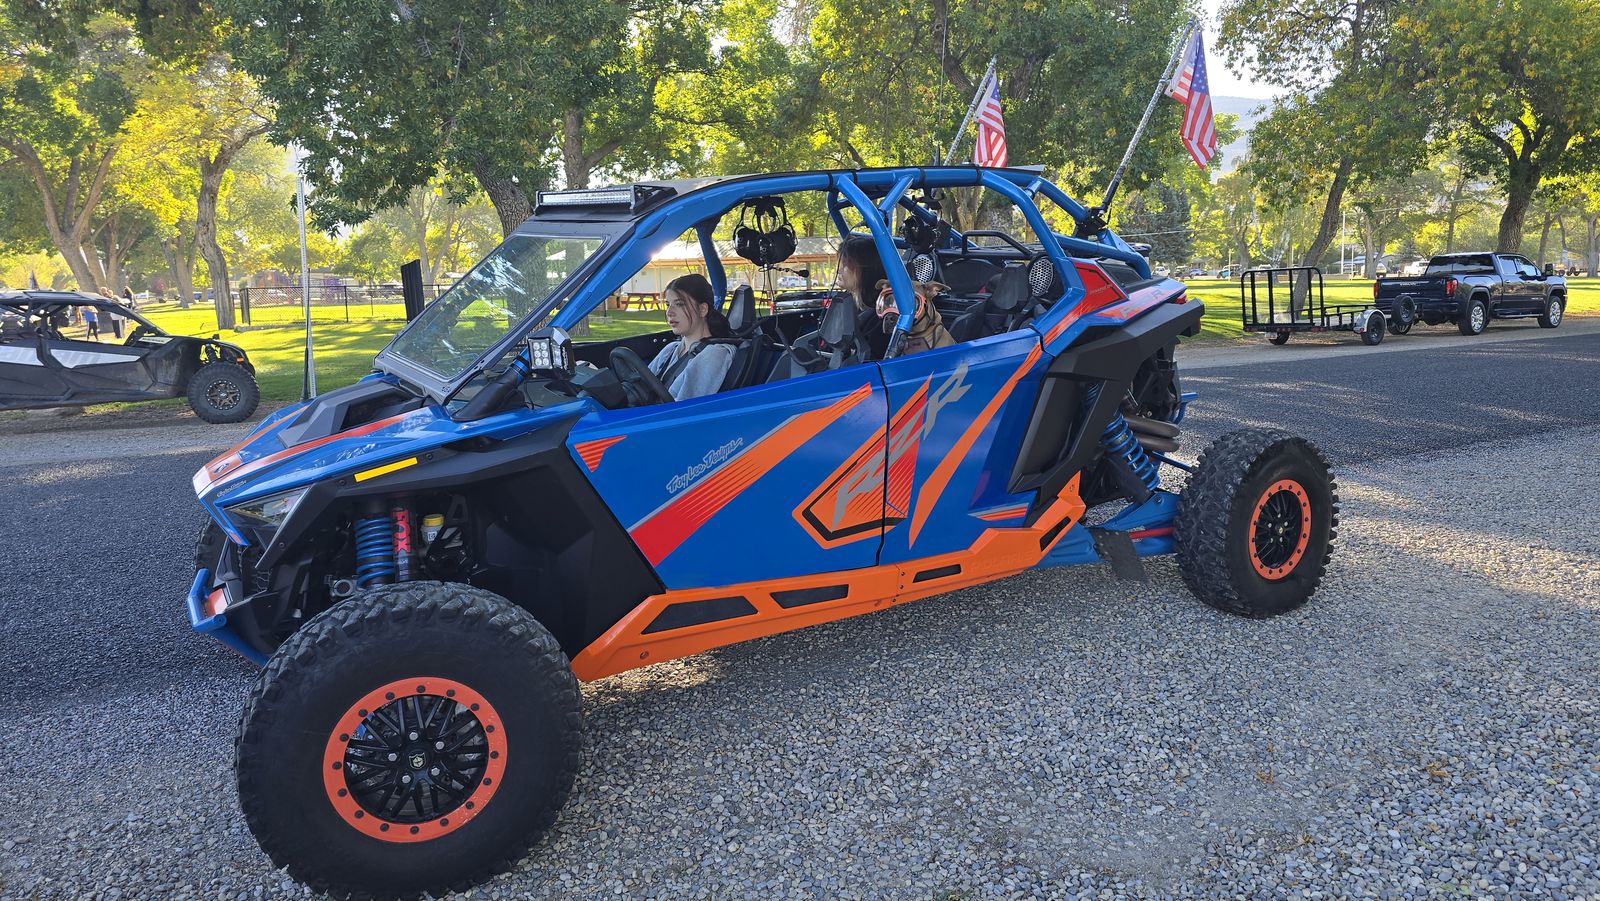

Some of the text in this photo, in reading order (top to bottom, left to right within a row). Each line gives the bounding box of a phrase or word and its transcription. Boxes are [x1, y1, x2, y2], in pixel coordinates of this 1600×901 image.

[666, 437, 743, 494] Troy Lee Designs
[831, 361, 973, 532] RZR
[391, 509, 411, 555] FOX
